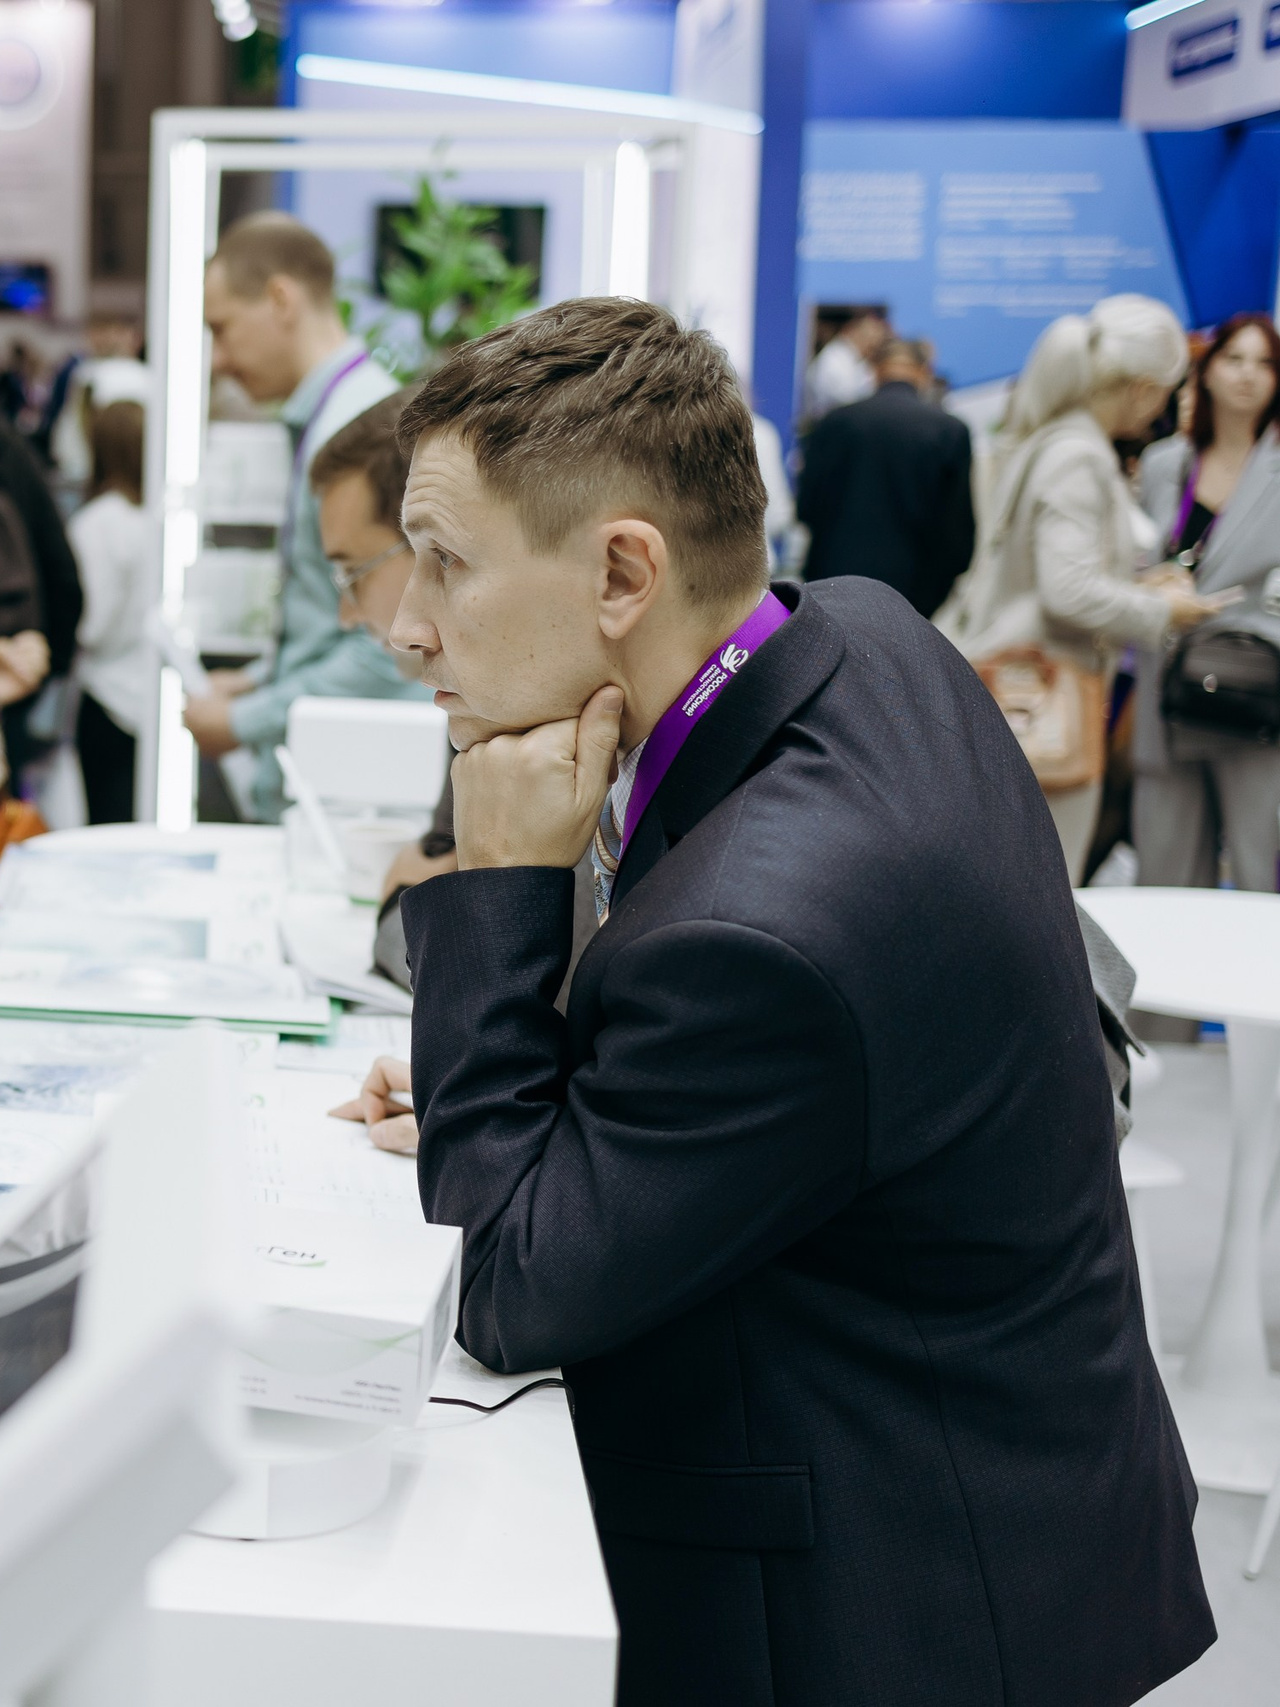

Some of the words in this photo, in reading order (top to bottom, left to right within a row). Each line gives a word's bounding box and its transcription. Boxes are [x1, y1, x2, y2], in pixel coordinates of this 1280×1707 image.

[682, 667, 721, 711] ДИАГНОСТИЧЕСКИЙ
[685, 672, 728, 717] РОССИЙСКИЙ
[699, 664, 717, 683] САММИТ
